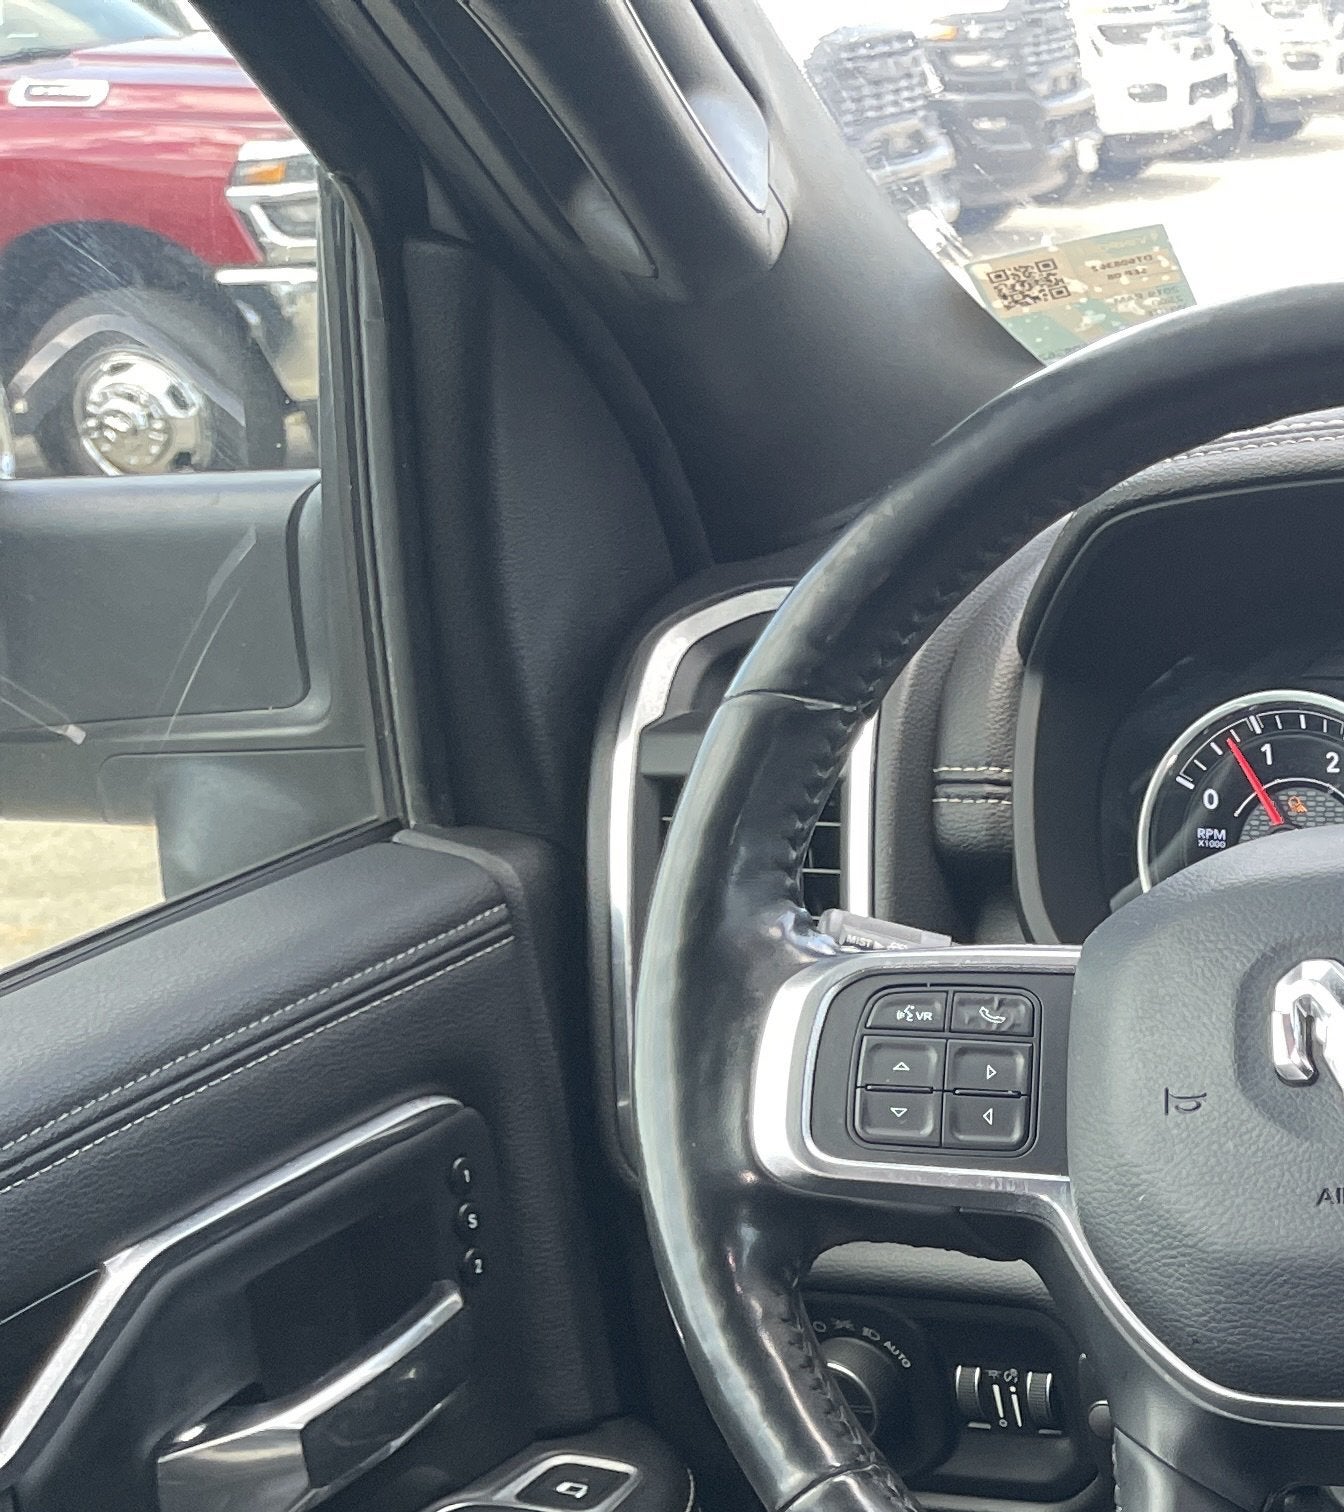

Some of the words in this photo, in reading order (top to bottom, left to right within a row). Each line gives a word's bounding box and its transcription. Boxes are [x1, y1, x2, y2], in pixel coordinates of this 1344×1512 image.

[1260, 743, 1273, 765] 1
[1326, 751, 1340, 773] 2
[1203, 789, 1219, 809] 0
[1197, 828, 1226, 840] RPM
[846, 934, 874, 948] MIST
[915, 1011, 933, 1020] VR
[468, 1213, 478, 1229] S
[474, 1259, 483, 1273] 2
[883, 1341, 912, 1368] AUTO
